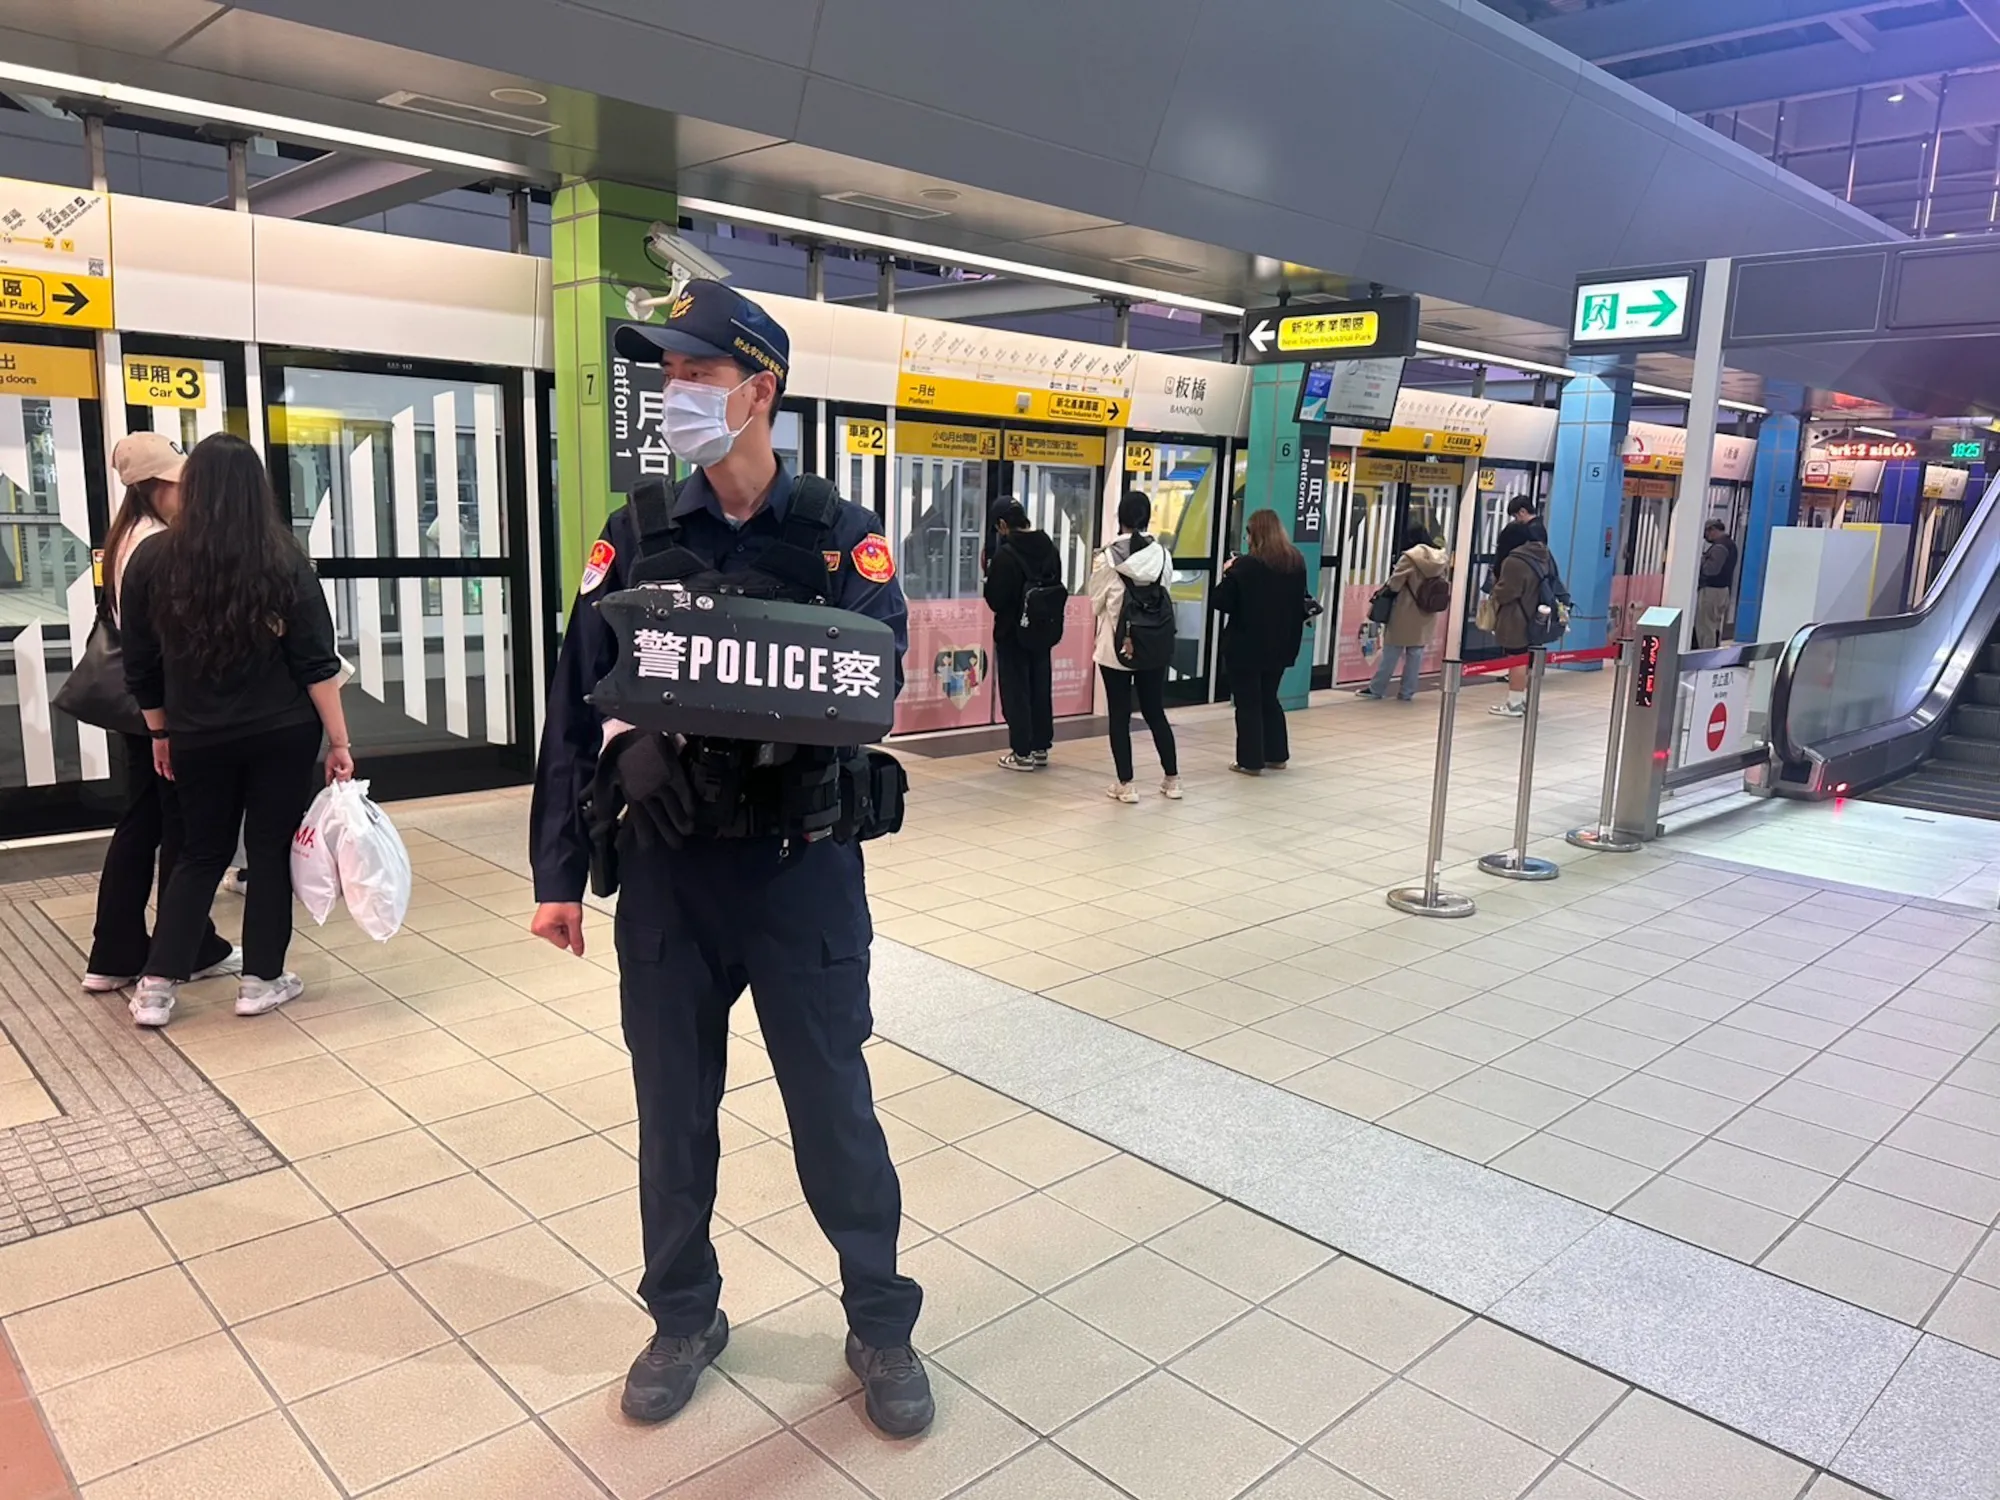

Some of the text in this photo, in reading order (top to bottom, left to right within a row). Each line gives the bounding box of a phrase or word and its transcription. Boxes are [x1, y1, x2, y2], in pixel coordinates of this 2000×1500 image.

[3, 278, 22, 296] 區
[10, 300, 38, 311] Park
[1291, 317, 1365, 334] 新北產業園區
[1282, 338, 1297, 346] New
[1320, 334, 1354, 344] Industrial
[1355, 334, 1372, 342] Park
[6, 374, 37, 385] doors
[129, 363, 201, 400] 車廂 3
[586, 374, 594, 395] 7
[1175, 375, 1206, 401] 板橋
[149, 386, 173, 398] Car
[909, 384, 936, 397] 一月台
[613, 357, 632, 457] latform 1
[1170, 405, 1204, 416] BANQIAO
[857, 440, 870, 449] Car
[872, 426, 883, 449] 2
[1143, 448, 1151, 466] 2
[1282, 443, 1291, 457] 6
[1298, 448, 1310, 510] Platform
[1592, 467, 1600, 477] 5
[1306, 459, 1325, 530] 一月台
